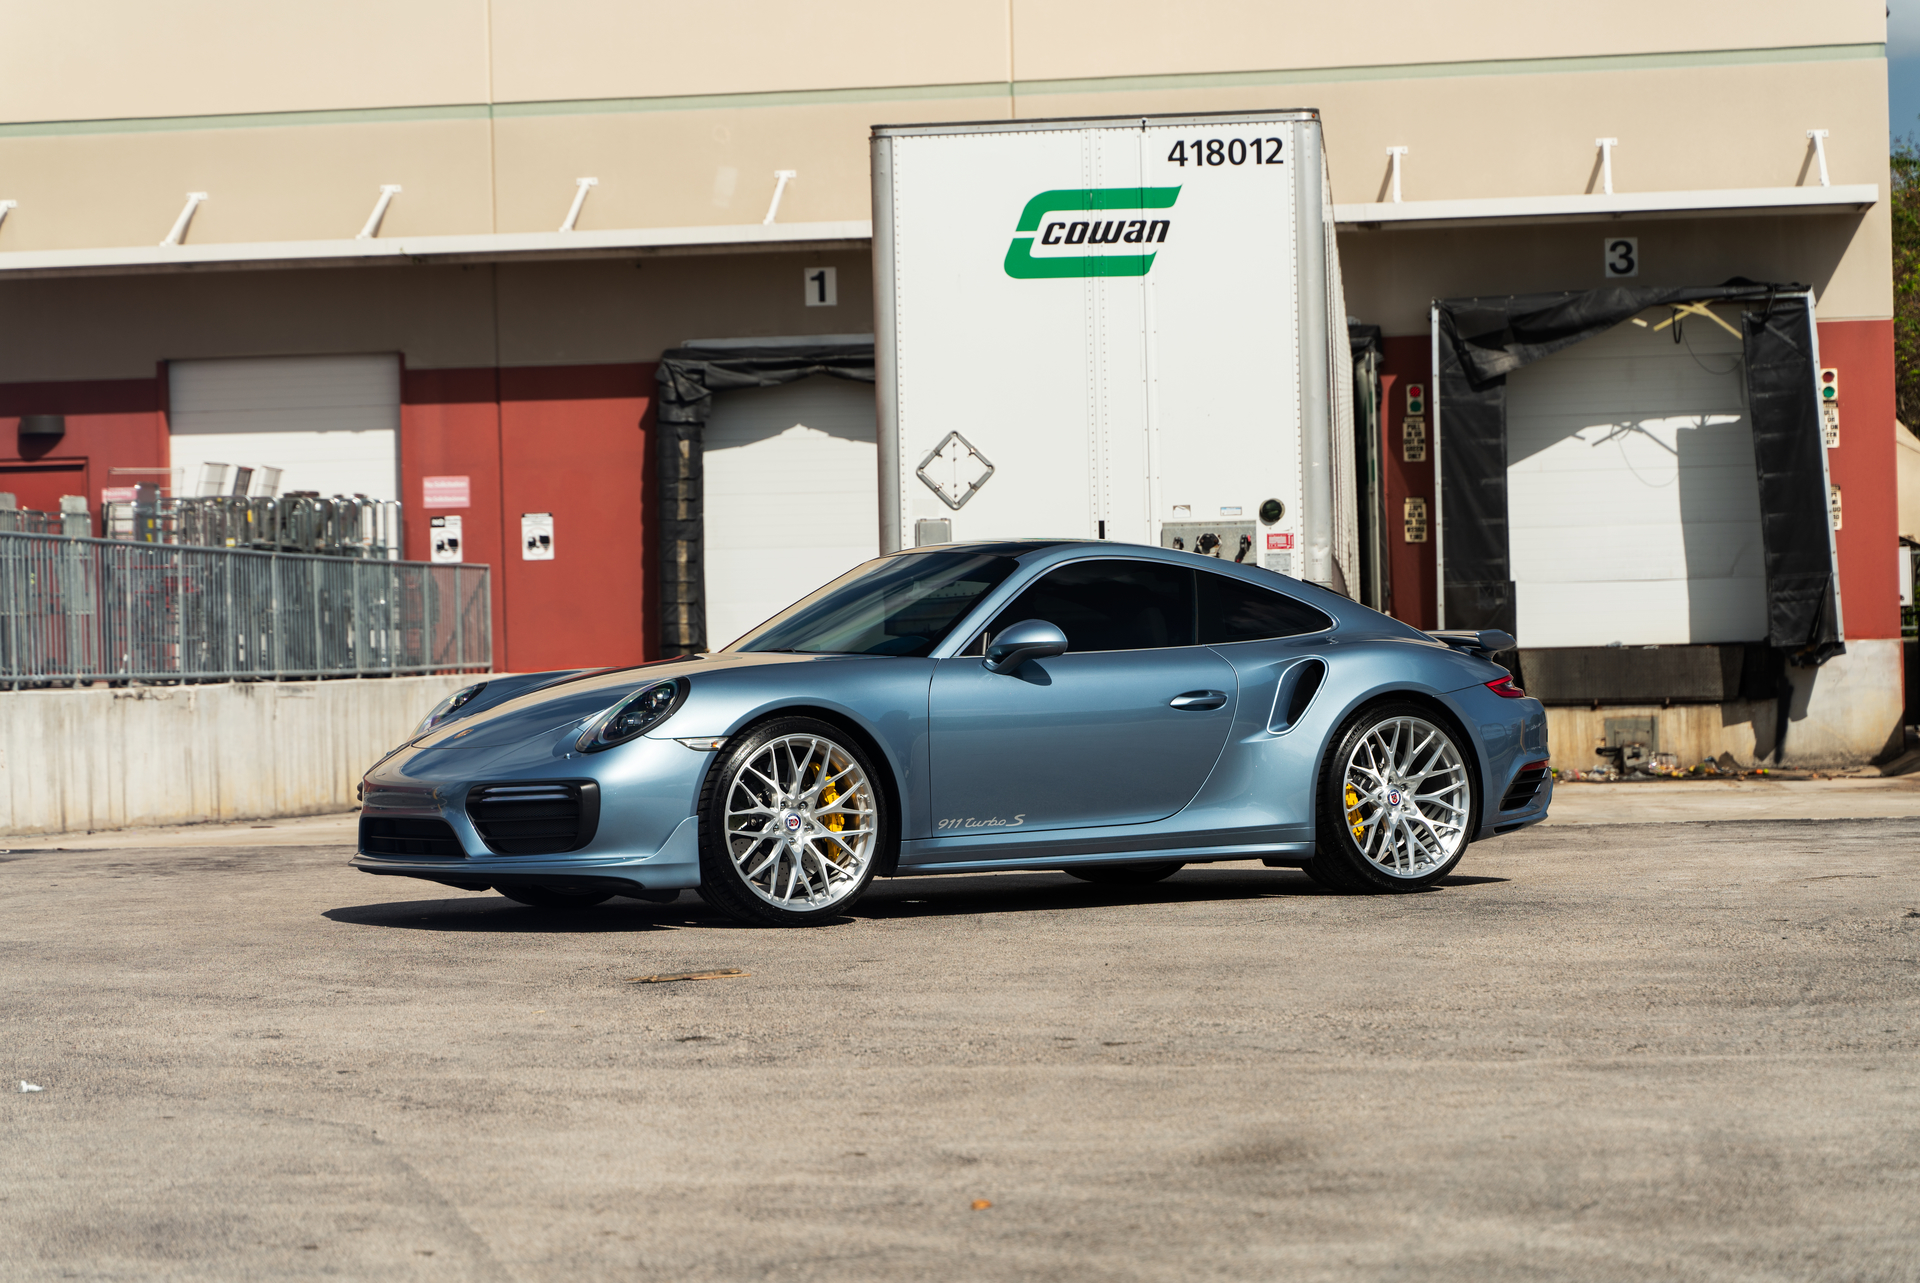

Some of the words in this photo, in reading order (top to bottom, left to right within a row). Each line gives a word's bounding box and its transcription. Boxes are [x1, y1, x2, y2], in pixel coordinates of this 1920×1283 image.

[1167, 137, 1284, 167] 418012
[1609, 240, 1635, 275] 3
[810, 270, 826, 303] 1
[431, 518, 445, 526] NO
[938, 818, 963, 830] 911
[964, 816, 1006, 828] turbo
[1005, 813, 1026, 827] S
